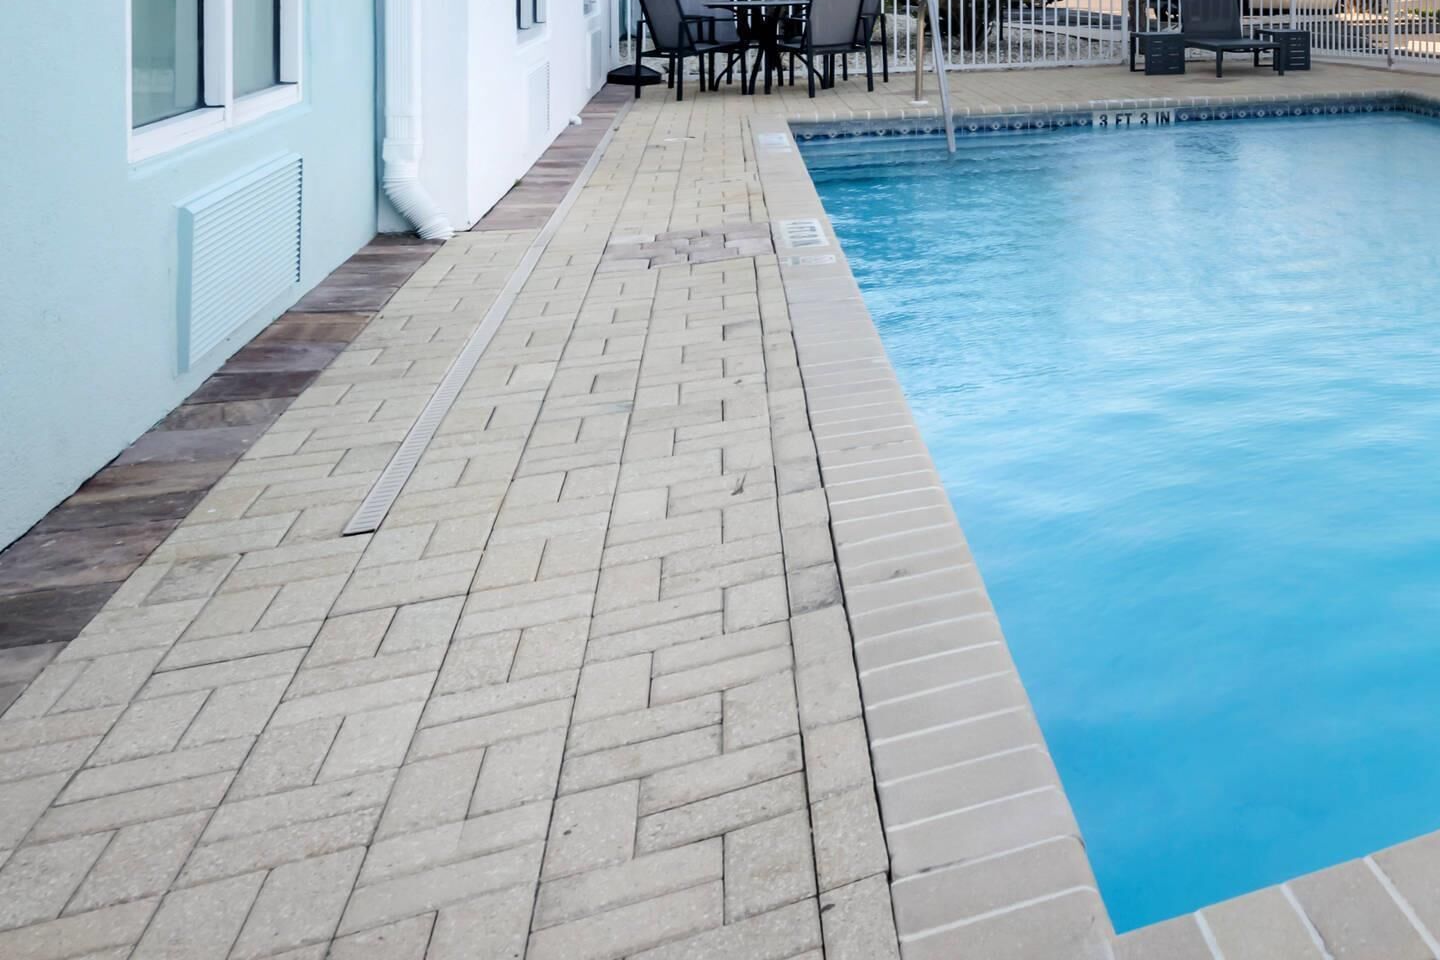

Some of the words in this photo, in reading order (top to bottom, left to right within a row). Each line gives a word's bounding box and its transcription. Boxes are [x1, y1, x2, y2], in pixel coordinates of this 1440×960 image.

[1100, 114, 1108, 126] 3
[1116, 113, 1132, 126] FT
[1140, 112, 1148, 125] 3
[1156, 111, 1170, 124] IN
